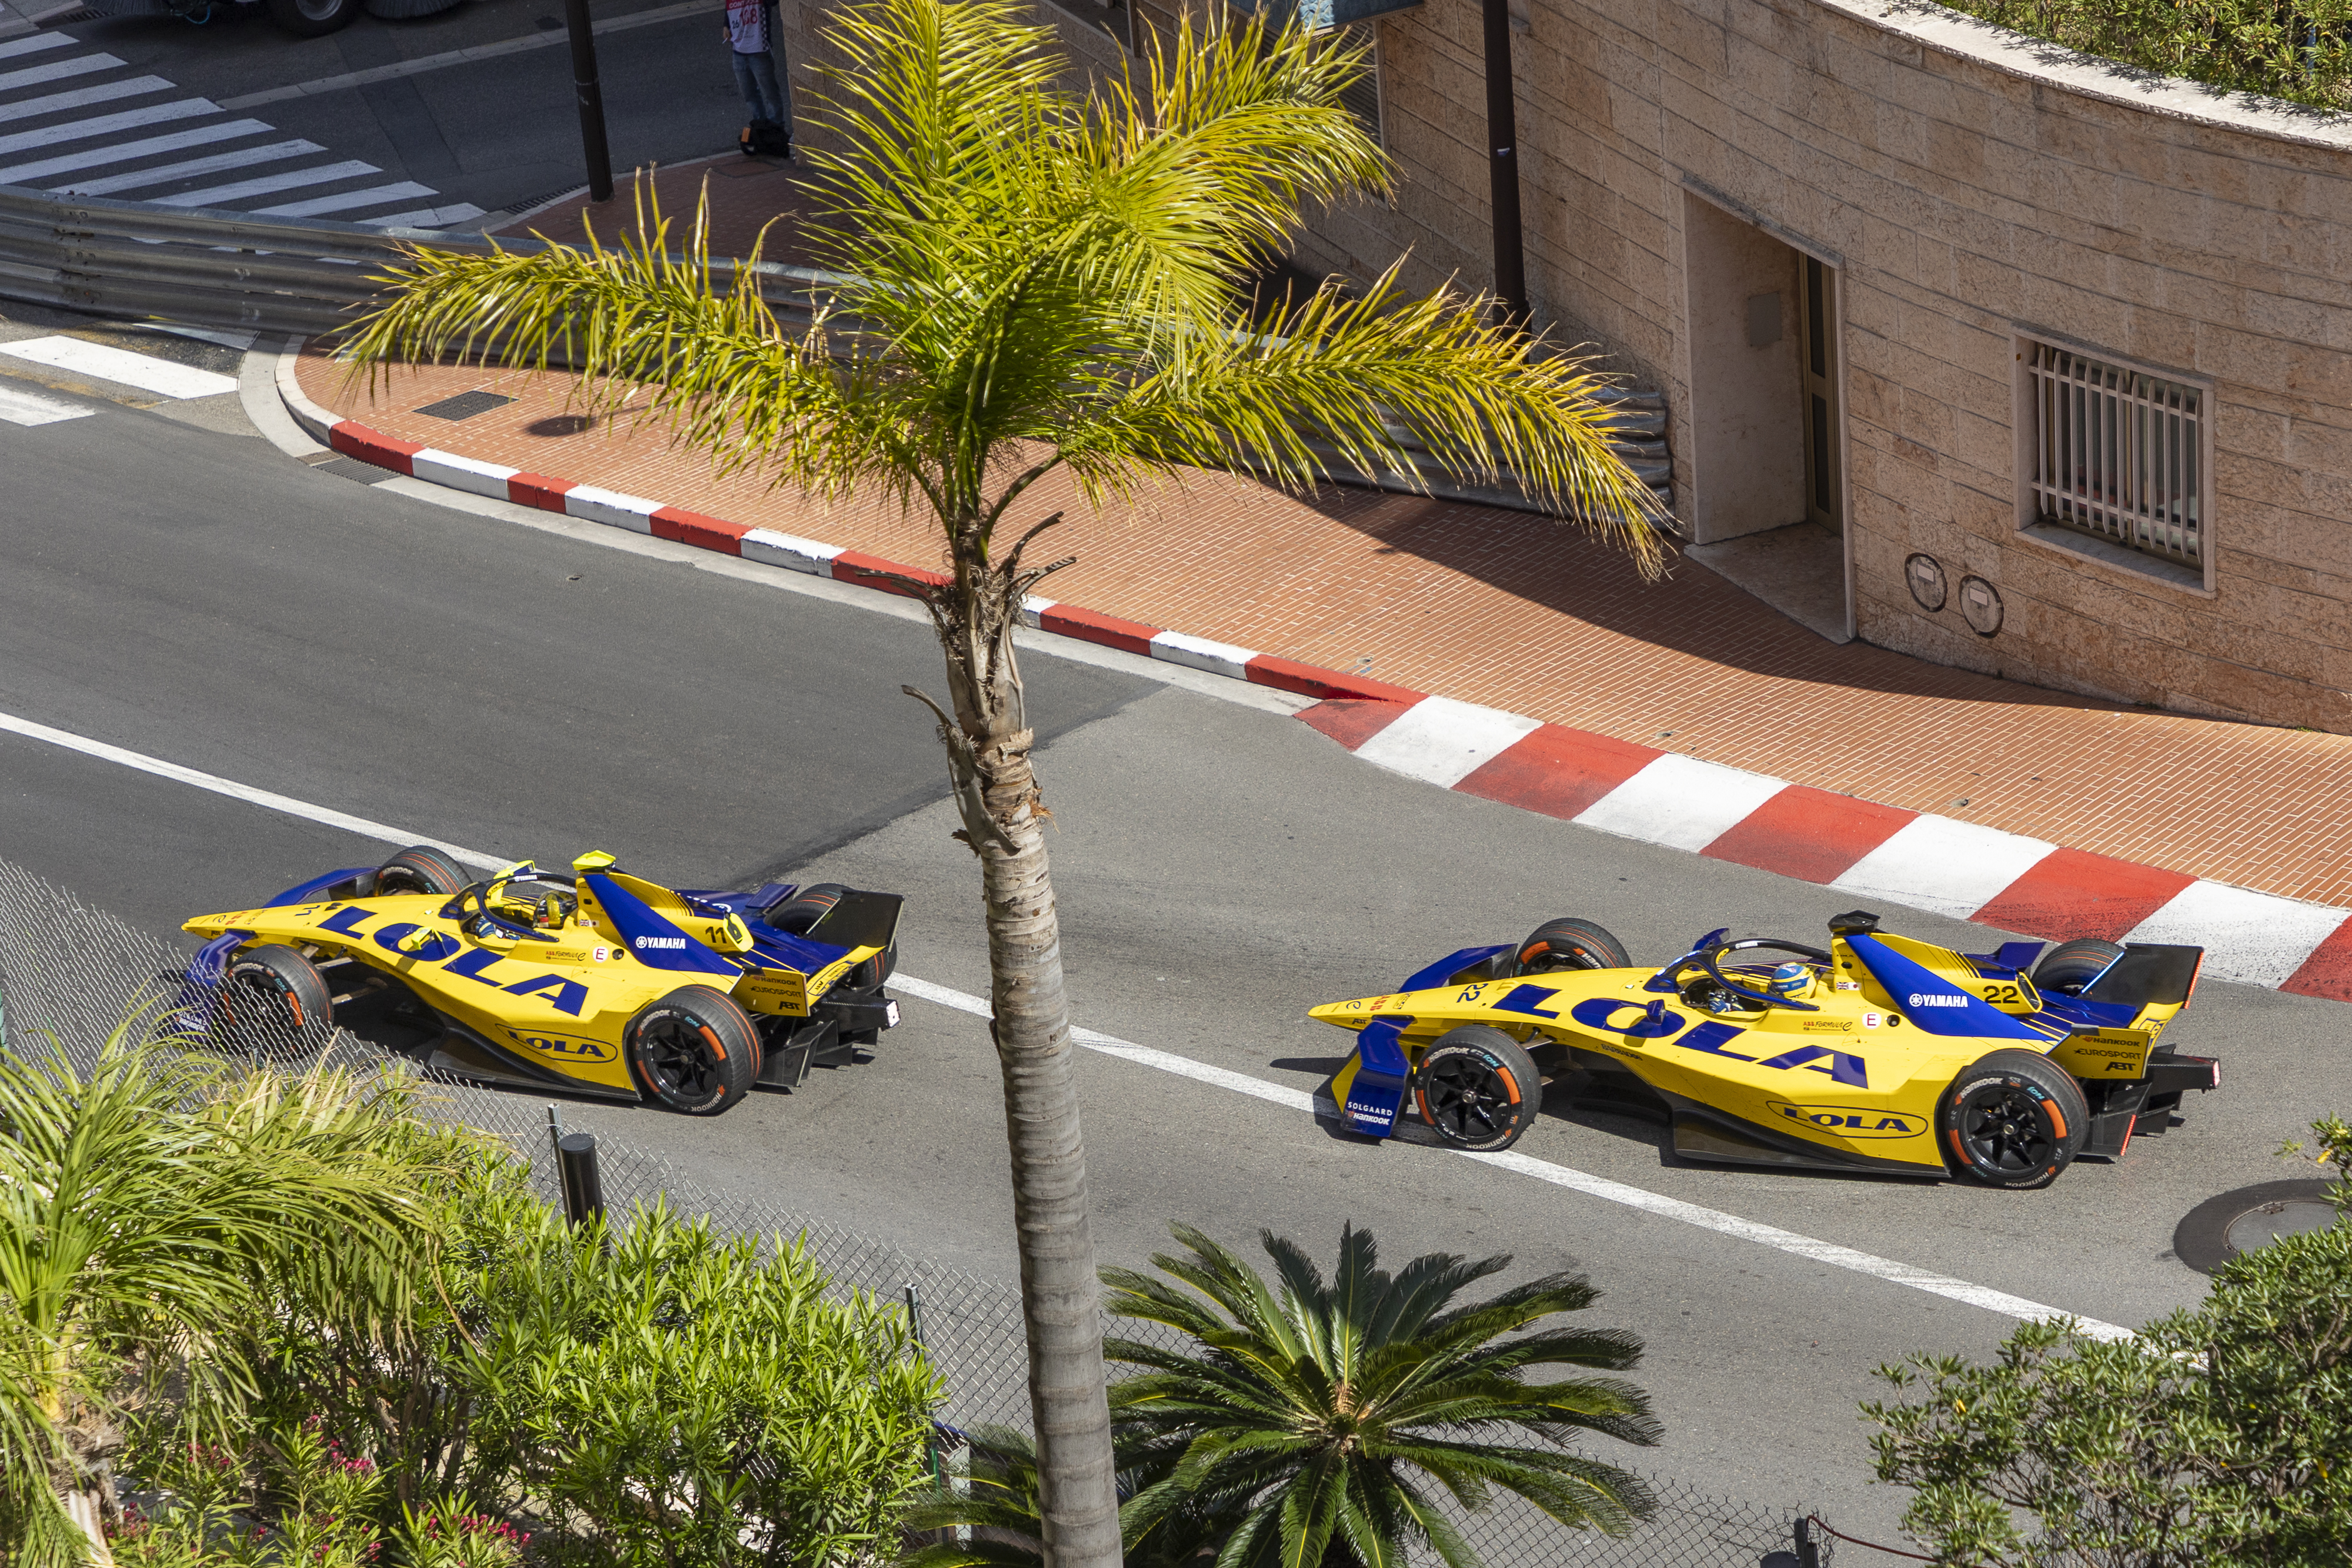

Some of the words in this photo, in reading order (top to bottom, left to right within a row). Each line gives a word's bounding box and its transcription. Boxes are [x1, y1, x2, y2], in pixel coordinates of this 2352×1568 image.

[732, 19, 739, 29] 26
[705, 926, 727, 944] 11
[647, 937, 686, 950] YAMAHA
[596, 948, 605, 960] E
[316, 906, 589, 1017] LOLA
[752, 986, 802, 998] EUROSPORT
[1456, 983, 1488, 1003] 22
[1983, 985, 2019, 1004] 22
[779, 1001, 800, 1010] ABT
[1922, 994, 1968, 1008] YAMAHA
[1867, 1014, 1876, 1026] E
[1490, 984, 1869, 1089] LOLA
[508, 1030, 606, 1058] LOLA
[2079, 1048, 2141, 1059] EUROSPORT
[2104, 1061, 2136, 1071] ABT
[1348, 1102, 1392, 1116] SOLGAARD
[1784, 1107, 1912, 1132] LOLA
